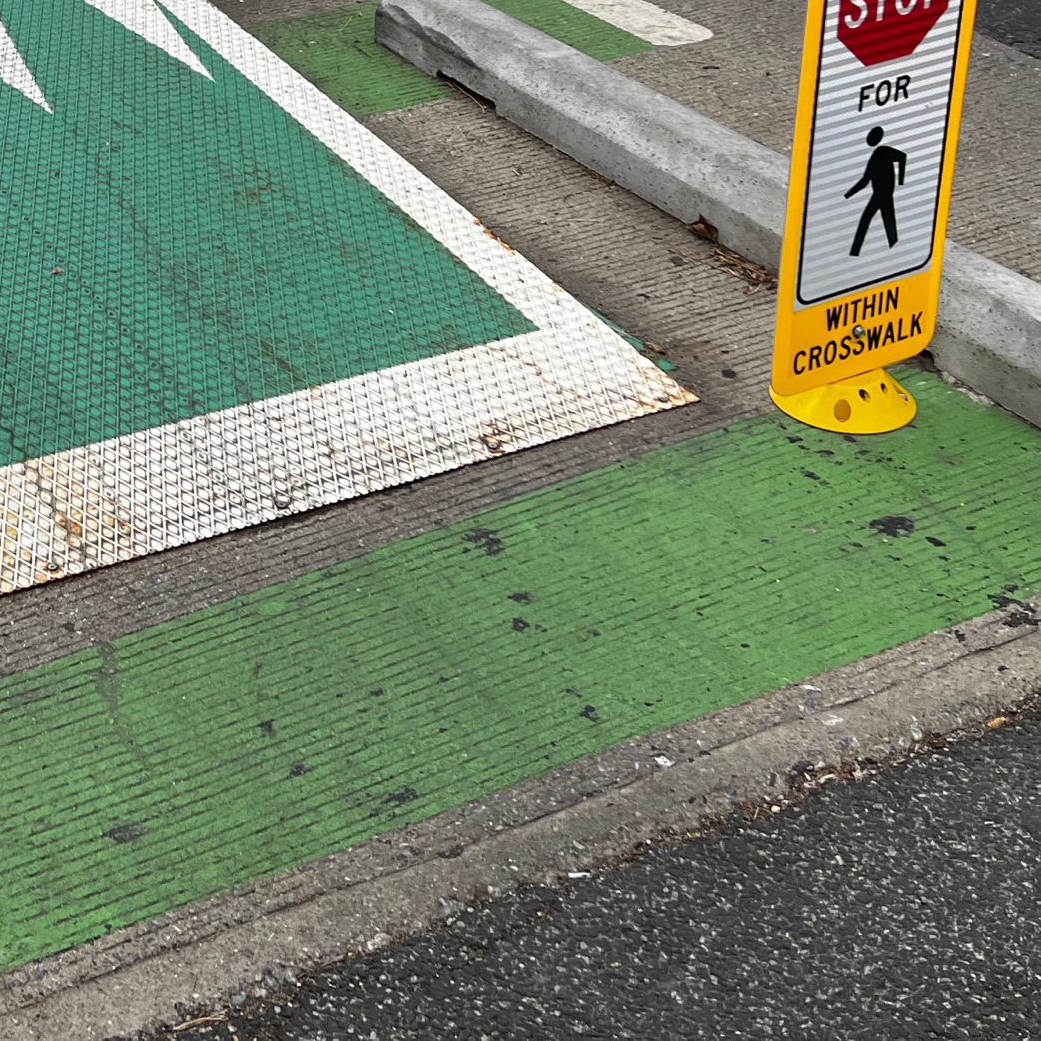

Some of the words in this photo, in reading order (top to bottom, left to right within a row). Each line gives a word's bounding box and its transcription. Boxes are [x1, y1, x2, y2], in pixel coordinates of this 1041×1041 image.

[858, 74, 911, 112] FOR
[826, 286, 900, 332] WITHIN
[793, 311, 923, 375] CROSSWALK
